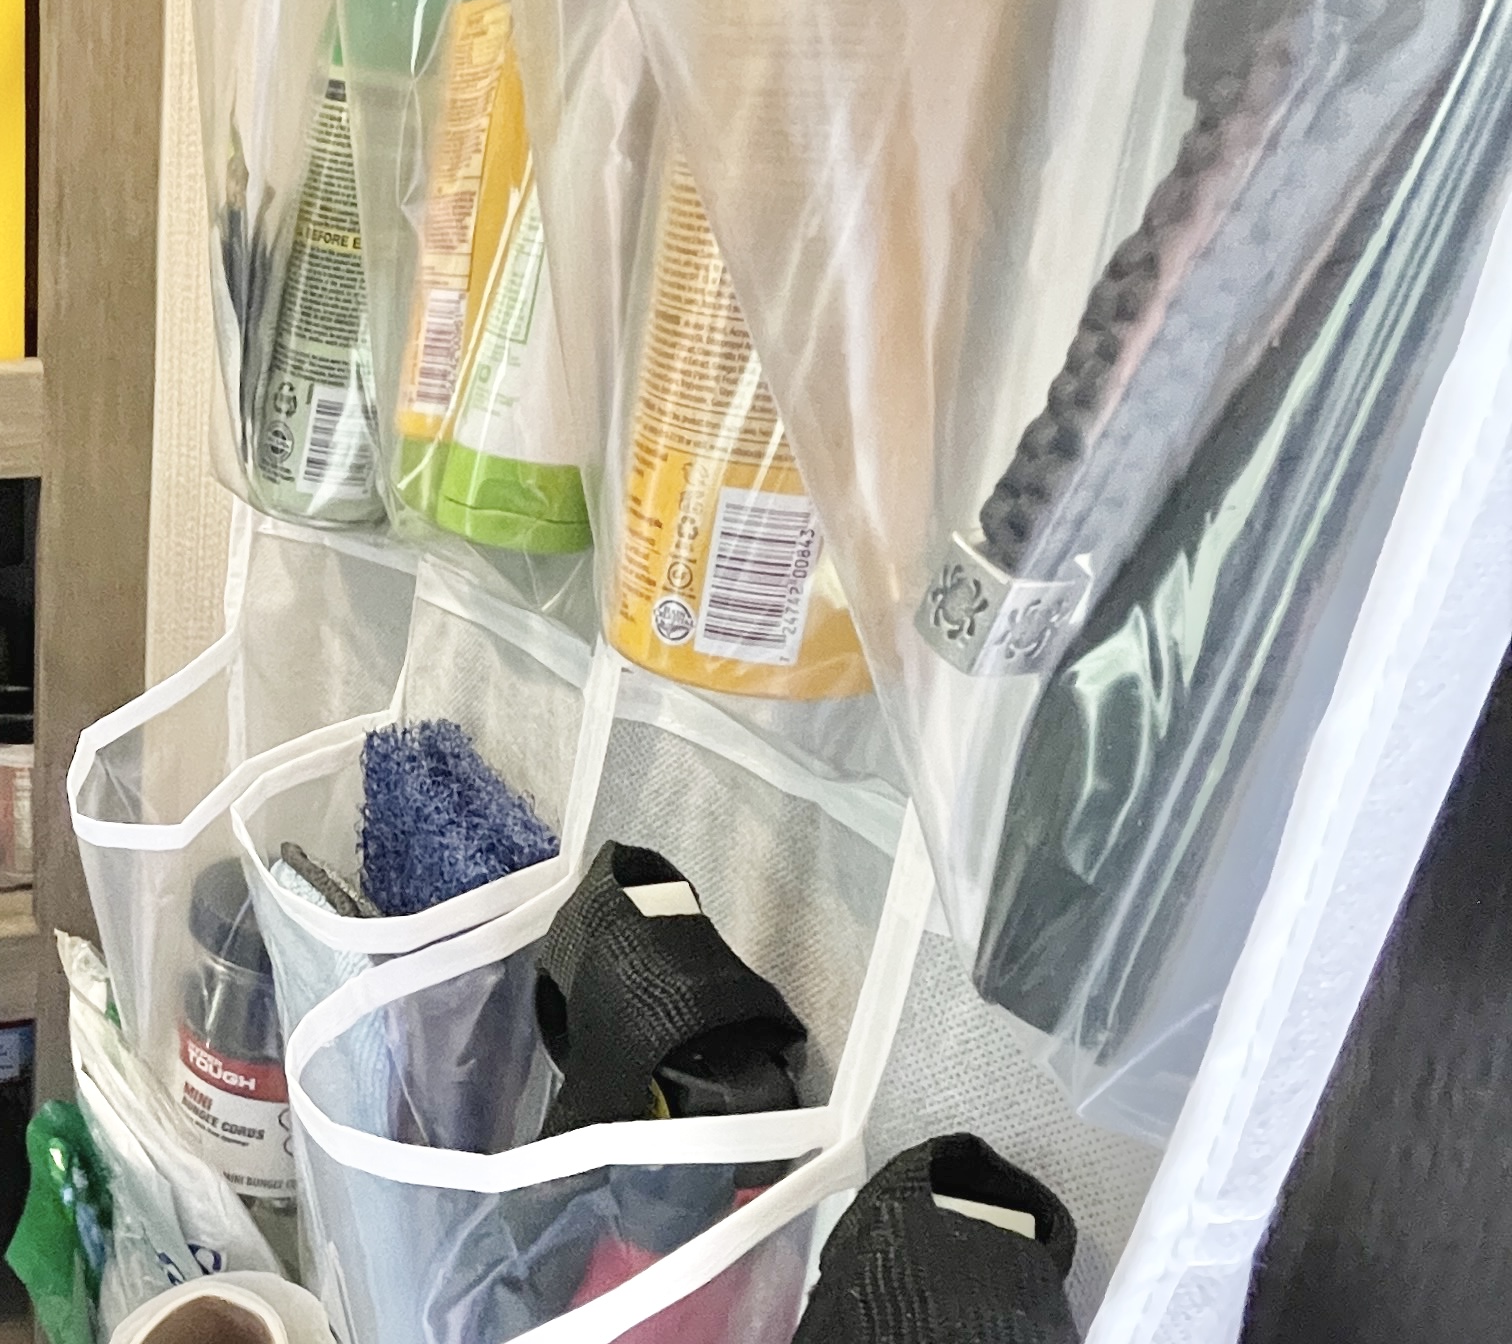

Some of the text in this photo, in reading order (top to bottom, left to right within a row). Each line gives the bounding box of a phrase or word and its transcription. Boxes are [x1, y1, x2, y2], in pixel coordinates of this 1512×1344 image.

[792, 528, 815, 579] 00843
[188, 1049, 257, 1091] TOUGH
[183, 1080, 213, 1111] MINI
[221, 1120, 265, 1141] CORDS
